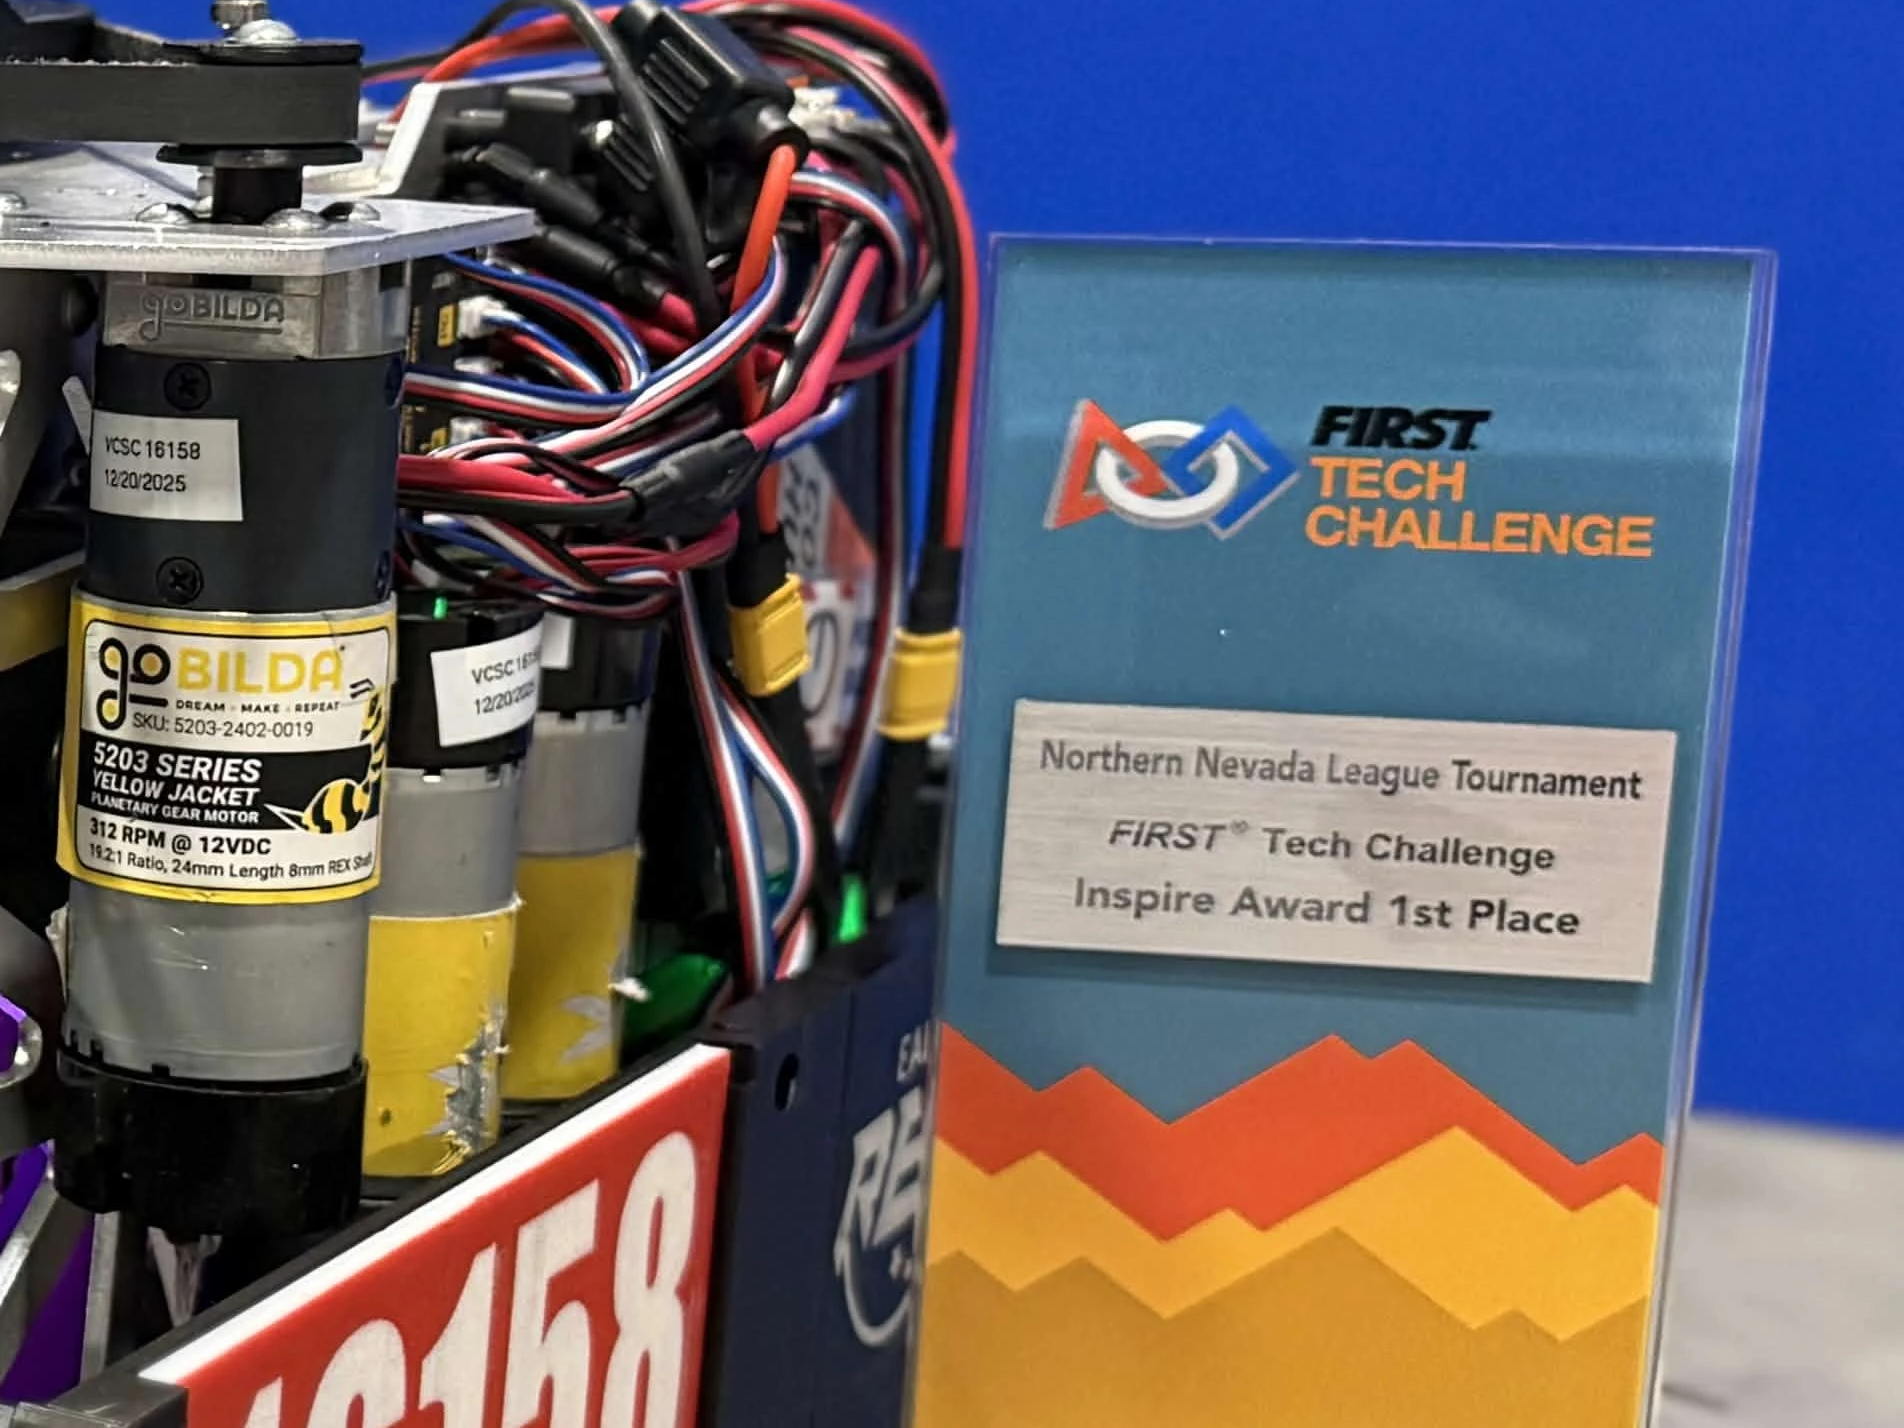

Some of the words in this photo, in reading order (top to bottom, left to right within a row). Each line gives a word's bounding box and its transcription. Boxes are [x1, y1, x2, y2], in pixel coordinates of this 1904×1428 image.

[105, 436, 141, 457] VCSC
[1309, 405, 1492, 451] FIRST
[1310, 456, 1467, 503] TECH
[1305, 504, 1656, 558] CHALLENGE
[471, 659, 514, 685] VCSC
[132, 711, 170, 733] SKU:
[174, 717, 314, 738] 5203-2402-0019
[176, 699, 225, 713] DREAM
[241, 703, 281, 714] MAKE
[295, 701, 341, 713] REPEAT
[93, 740, 150, 773] 5203
[155, 752, 263, 783] SERIES
[1039, 739, 1184, 777] Northern
[1194, 745, 1315, 784] Nevada
[1326, 753, 1441, 797] League
[1451, 758, 1643, 800] Tournament
[91, 791, 159, 816] PLANETARY
[161, 805, 201, 821] GEAR
[203, 808, 260, 824] MOTOR
[92, 769, 165, 800] YELLOW
[167, 783, 261, 807] JACKET
[89, 817, 118, 840] 312
[121, 824, 166, 849] RPM
[171, 834, 192, 856] @
[199, 836, 272, 855] 12VDC
[1262, 827, 1351, 860] Tech
[1365, 832, 1556, 876] Challenge
[127, 851, 168, 874] Ratio,
[172, 859, 224, 878] 24mm
[229, 862, 285, 882] Length
[289, 863, 325, 878] 8mm
[328, 859, 352, 875] REX
[1073, 876, 1216, 920] Inspire
[1229, 886, 1372, 923] Award
[1389, 894, 1453, 929] 1st
[1467, 897, 1581, 935] Place
